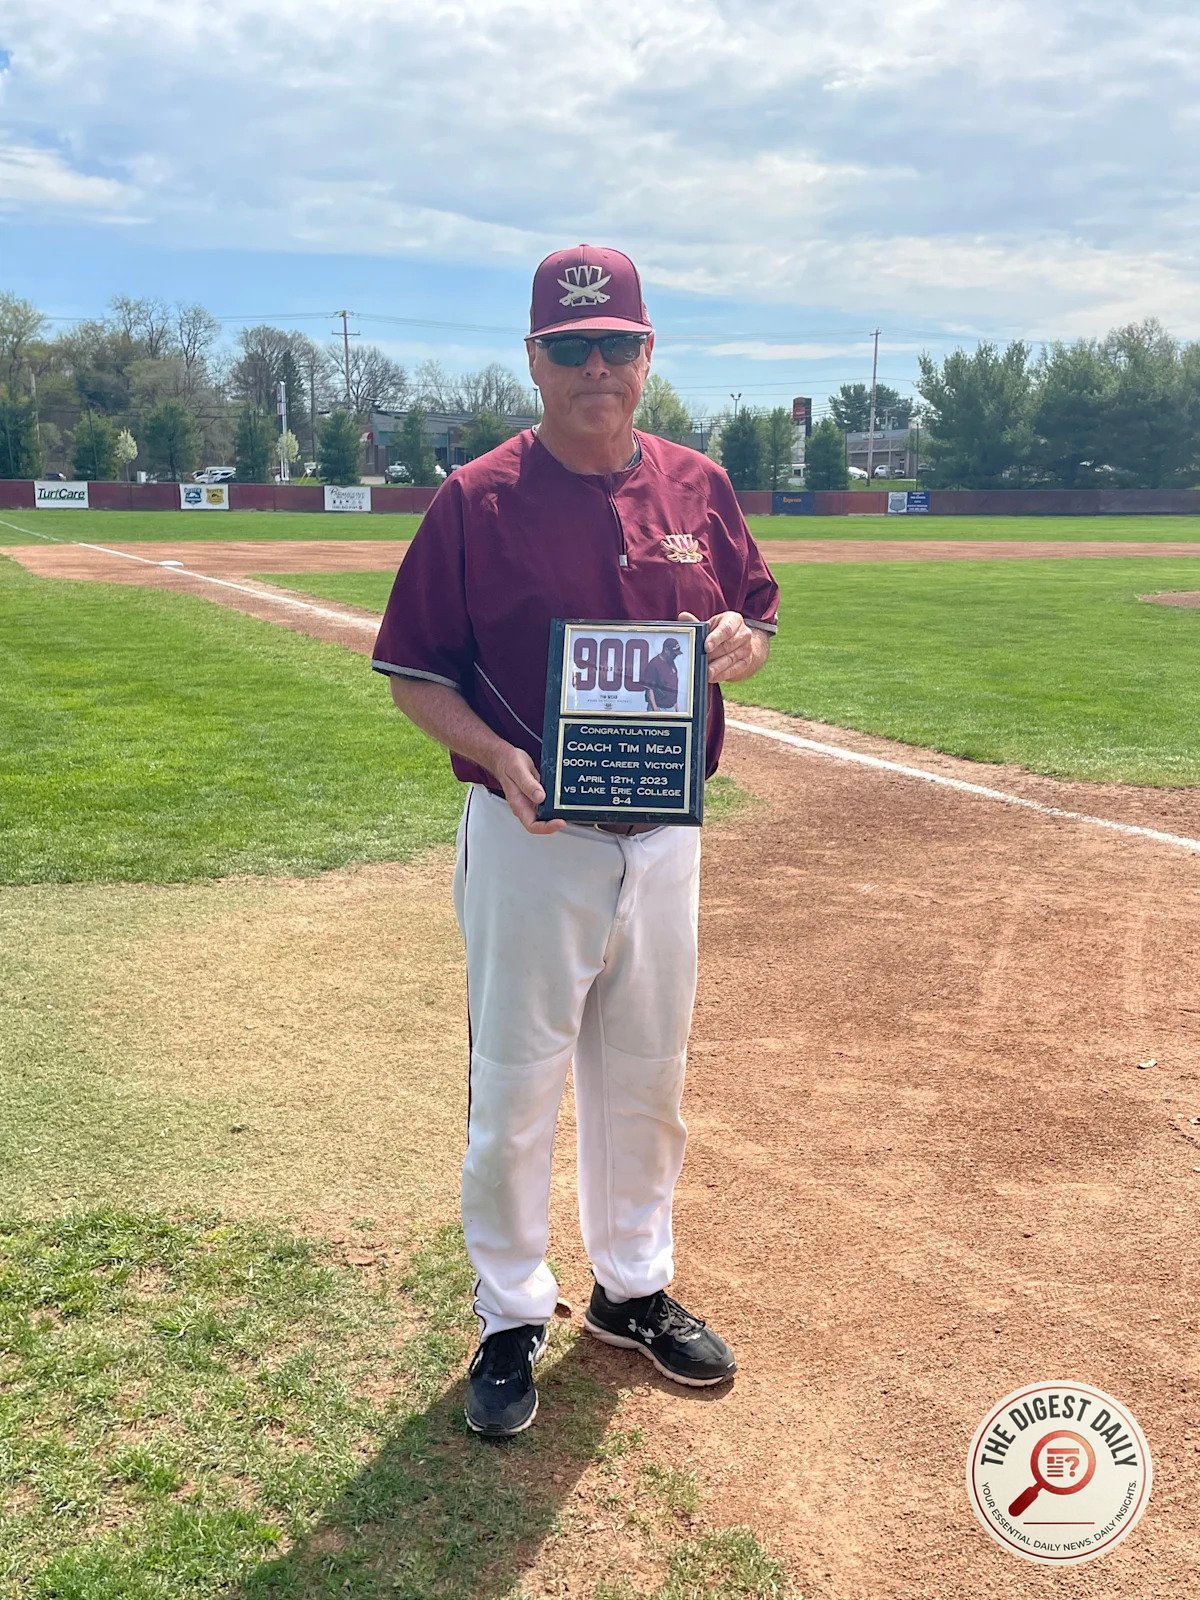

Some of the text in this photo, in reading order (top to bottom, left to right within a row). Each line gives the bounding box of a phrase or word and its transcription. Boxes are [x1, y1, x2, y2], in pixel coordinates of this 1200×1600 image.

[37, 488, 86, 500] TurfCare
[573, 638, 649, 692] 900
[580, 726, 671, 737] CONGRATULATIONS
[567, 741, 682, 755] COACH TIM MEAD
[562, 759, 685, 771] 900TH CAREER VICTORY
[577, 775, 669, 786] APRIL 12TH, 2023
[564, 786, 682, 797] VS LAKE ERIE COLLEGE
[612, 797, 632, 805] 8-4
